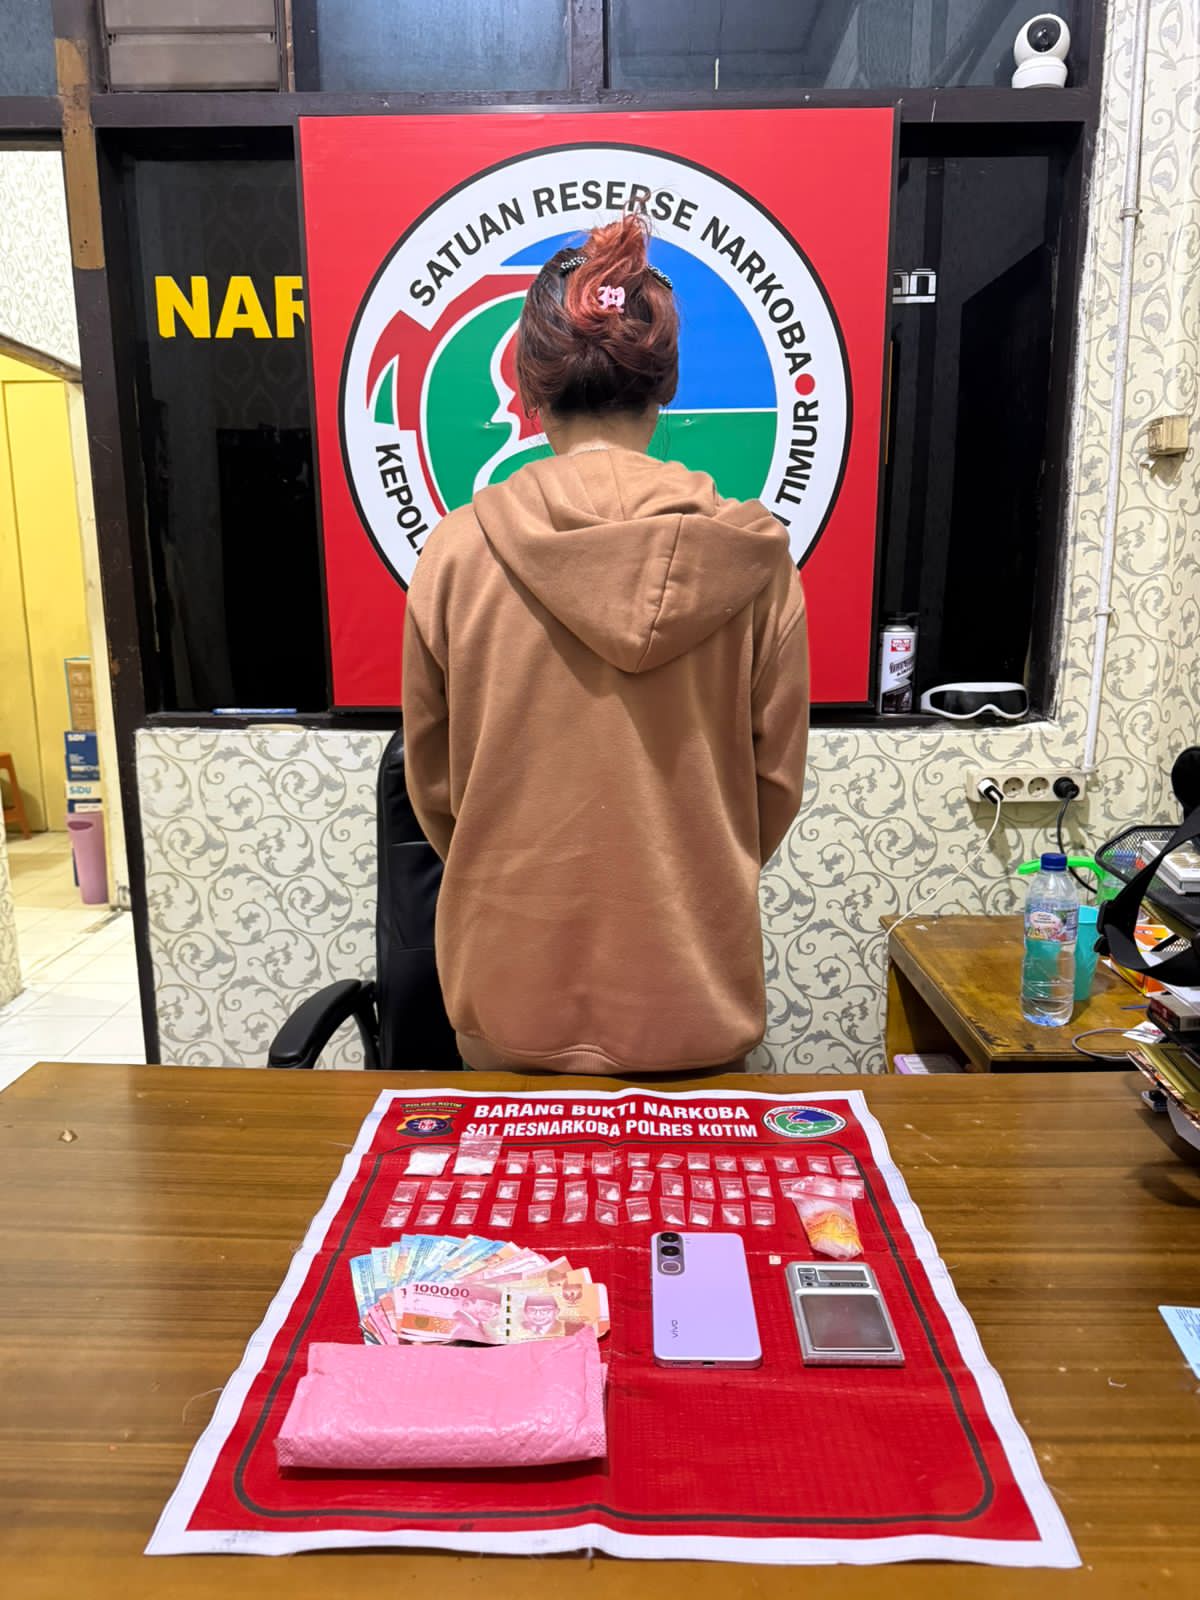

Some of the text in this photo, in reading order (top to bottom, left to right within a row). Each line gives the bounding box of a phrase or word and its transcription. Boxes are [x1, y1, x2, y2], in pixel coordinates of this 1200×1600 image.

[409, 180, 812, 376] SATUAN RESERSE NARKOBA
[775, 399, 819, 505] TIMUR
[375, 443, 429, 557] KEPOL
[464, 1119, 758, 1138] SAT RESNARKOBA POLRES KOTIM
[473, 1101, 750, 1119] BARANG BUKTI NARKOBA
[413, 1284, 470, 1298] 100000
